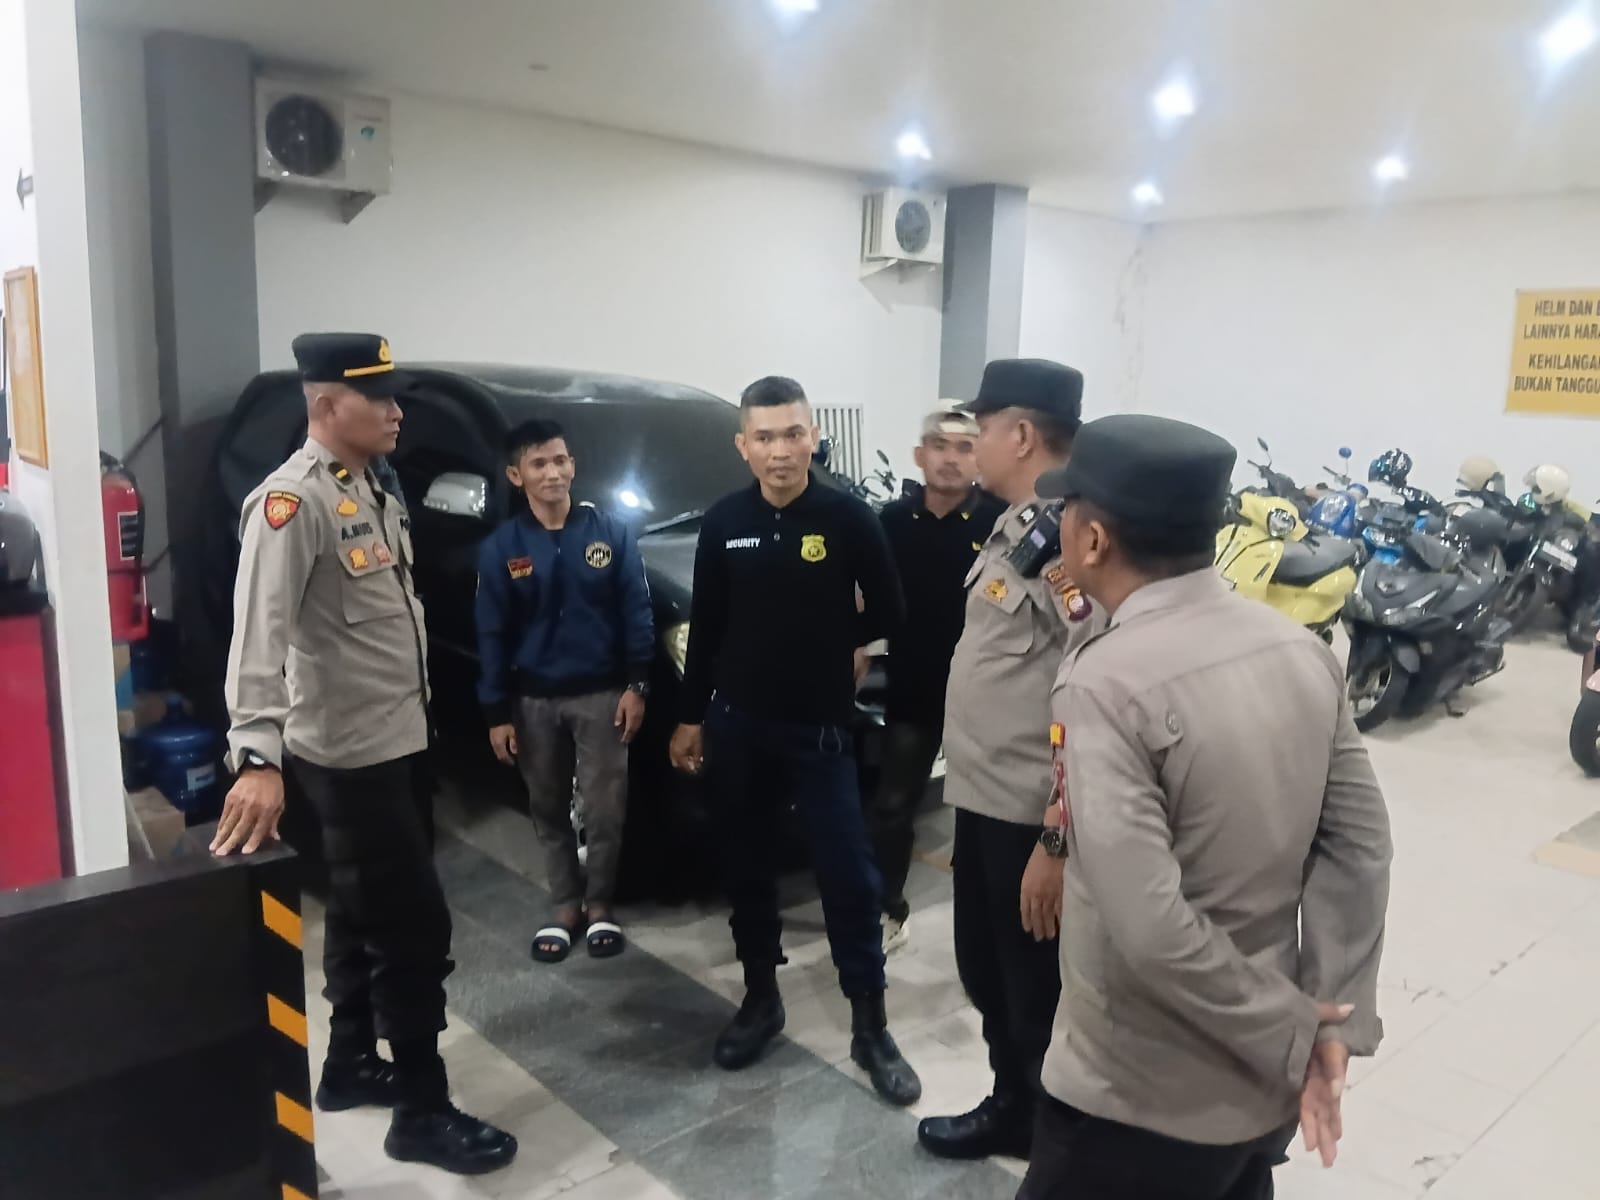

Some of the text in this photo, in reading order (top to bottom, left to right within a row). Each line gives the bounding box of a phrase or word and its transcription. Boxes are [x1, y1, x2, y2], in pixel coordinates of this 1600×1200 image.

[1535, 300, 1565, 316] HELM
[1569, 300, 1593, 316] DAN
[1524, 324, 1600, 339] LAINNYA HAR
[1529, 354, 1600, 370] KEHILANGA
[1514, 376, 1552, 392] BUKAN
